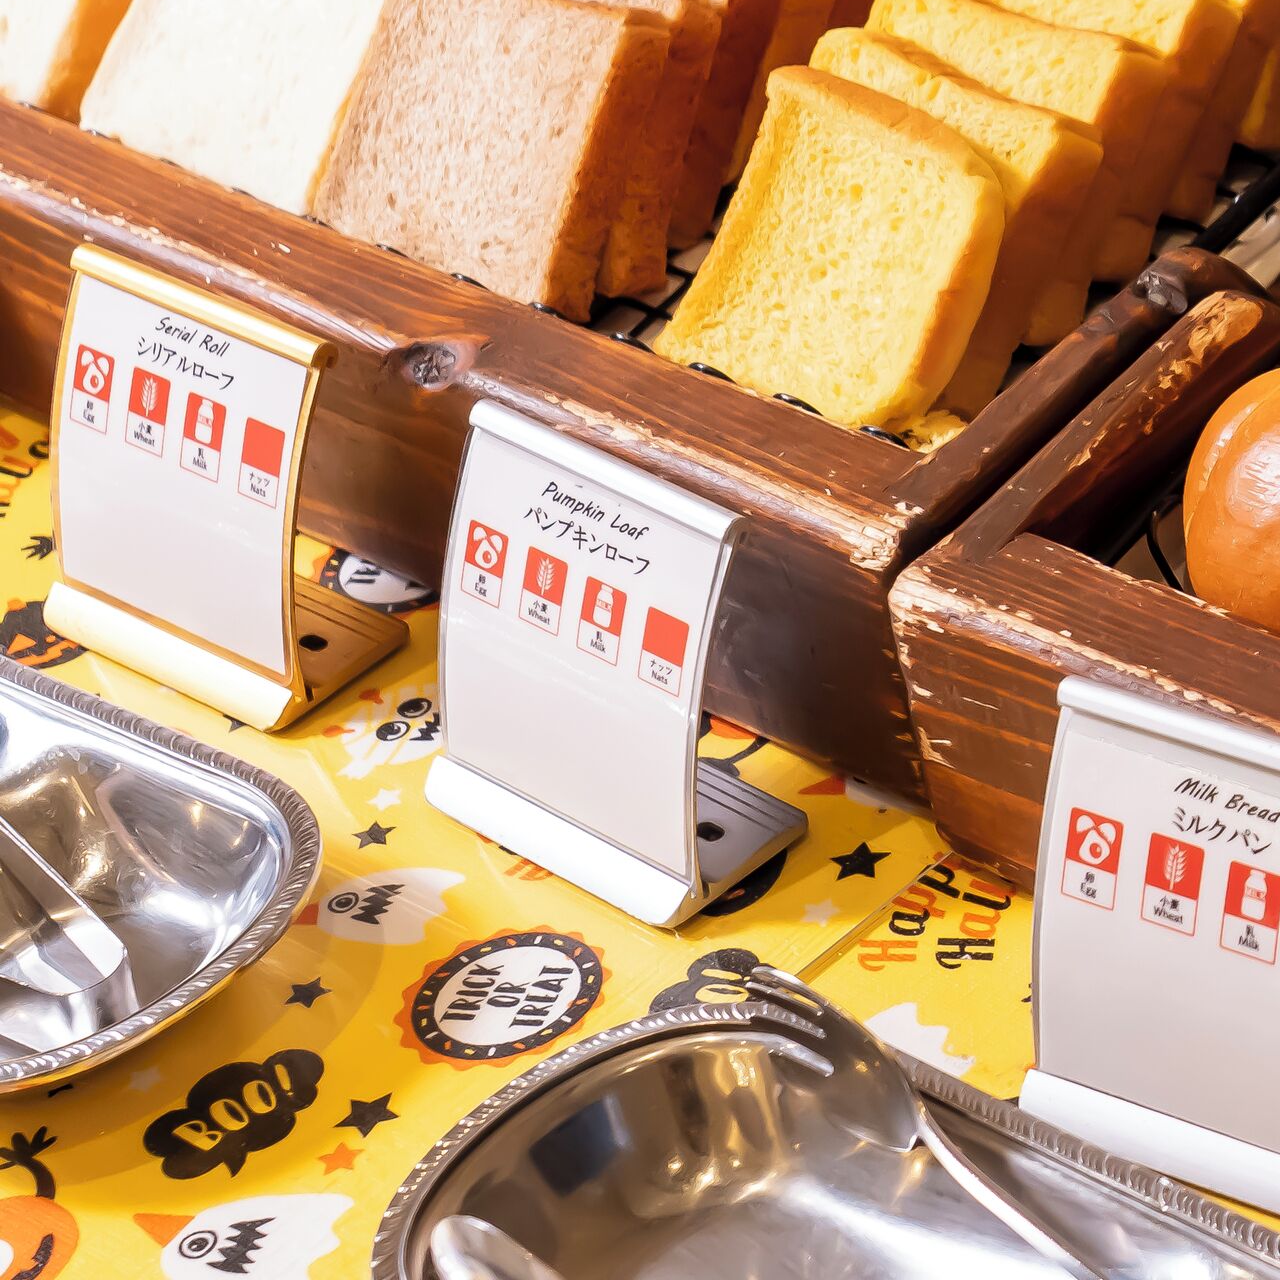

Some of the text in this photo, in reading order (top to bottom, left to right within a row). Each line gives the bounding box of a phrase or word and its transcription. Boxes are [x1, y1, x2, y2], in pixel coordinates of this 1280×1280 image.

[155, 317, 231, 358] Serial Roll
[136, 336, 235, 391] シリアルローフ
[133, 430, 155, 447] Wheat
[192, 457, 208, 471] Milk
[541, 481, 649, 540] Pumpkin Loaf
[524, 507, 650, 575] パンプキンローフ
[528, 608, 550, 625] Wheat
[1173, 777, 1219, 804] Milk
[1171, 806, 1273, 855] ミルクパン
[1153, 906, 1184, 925] Wheat
[1238, 935, 1260, 951] Milk
[440, 963, 505, 1023] TRICK
[486, 981, 532, 1008] OR
[508, 965, 574, 1029] TREAT
[171, 1063, 295, 1151] BOO!
